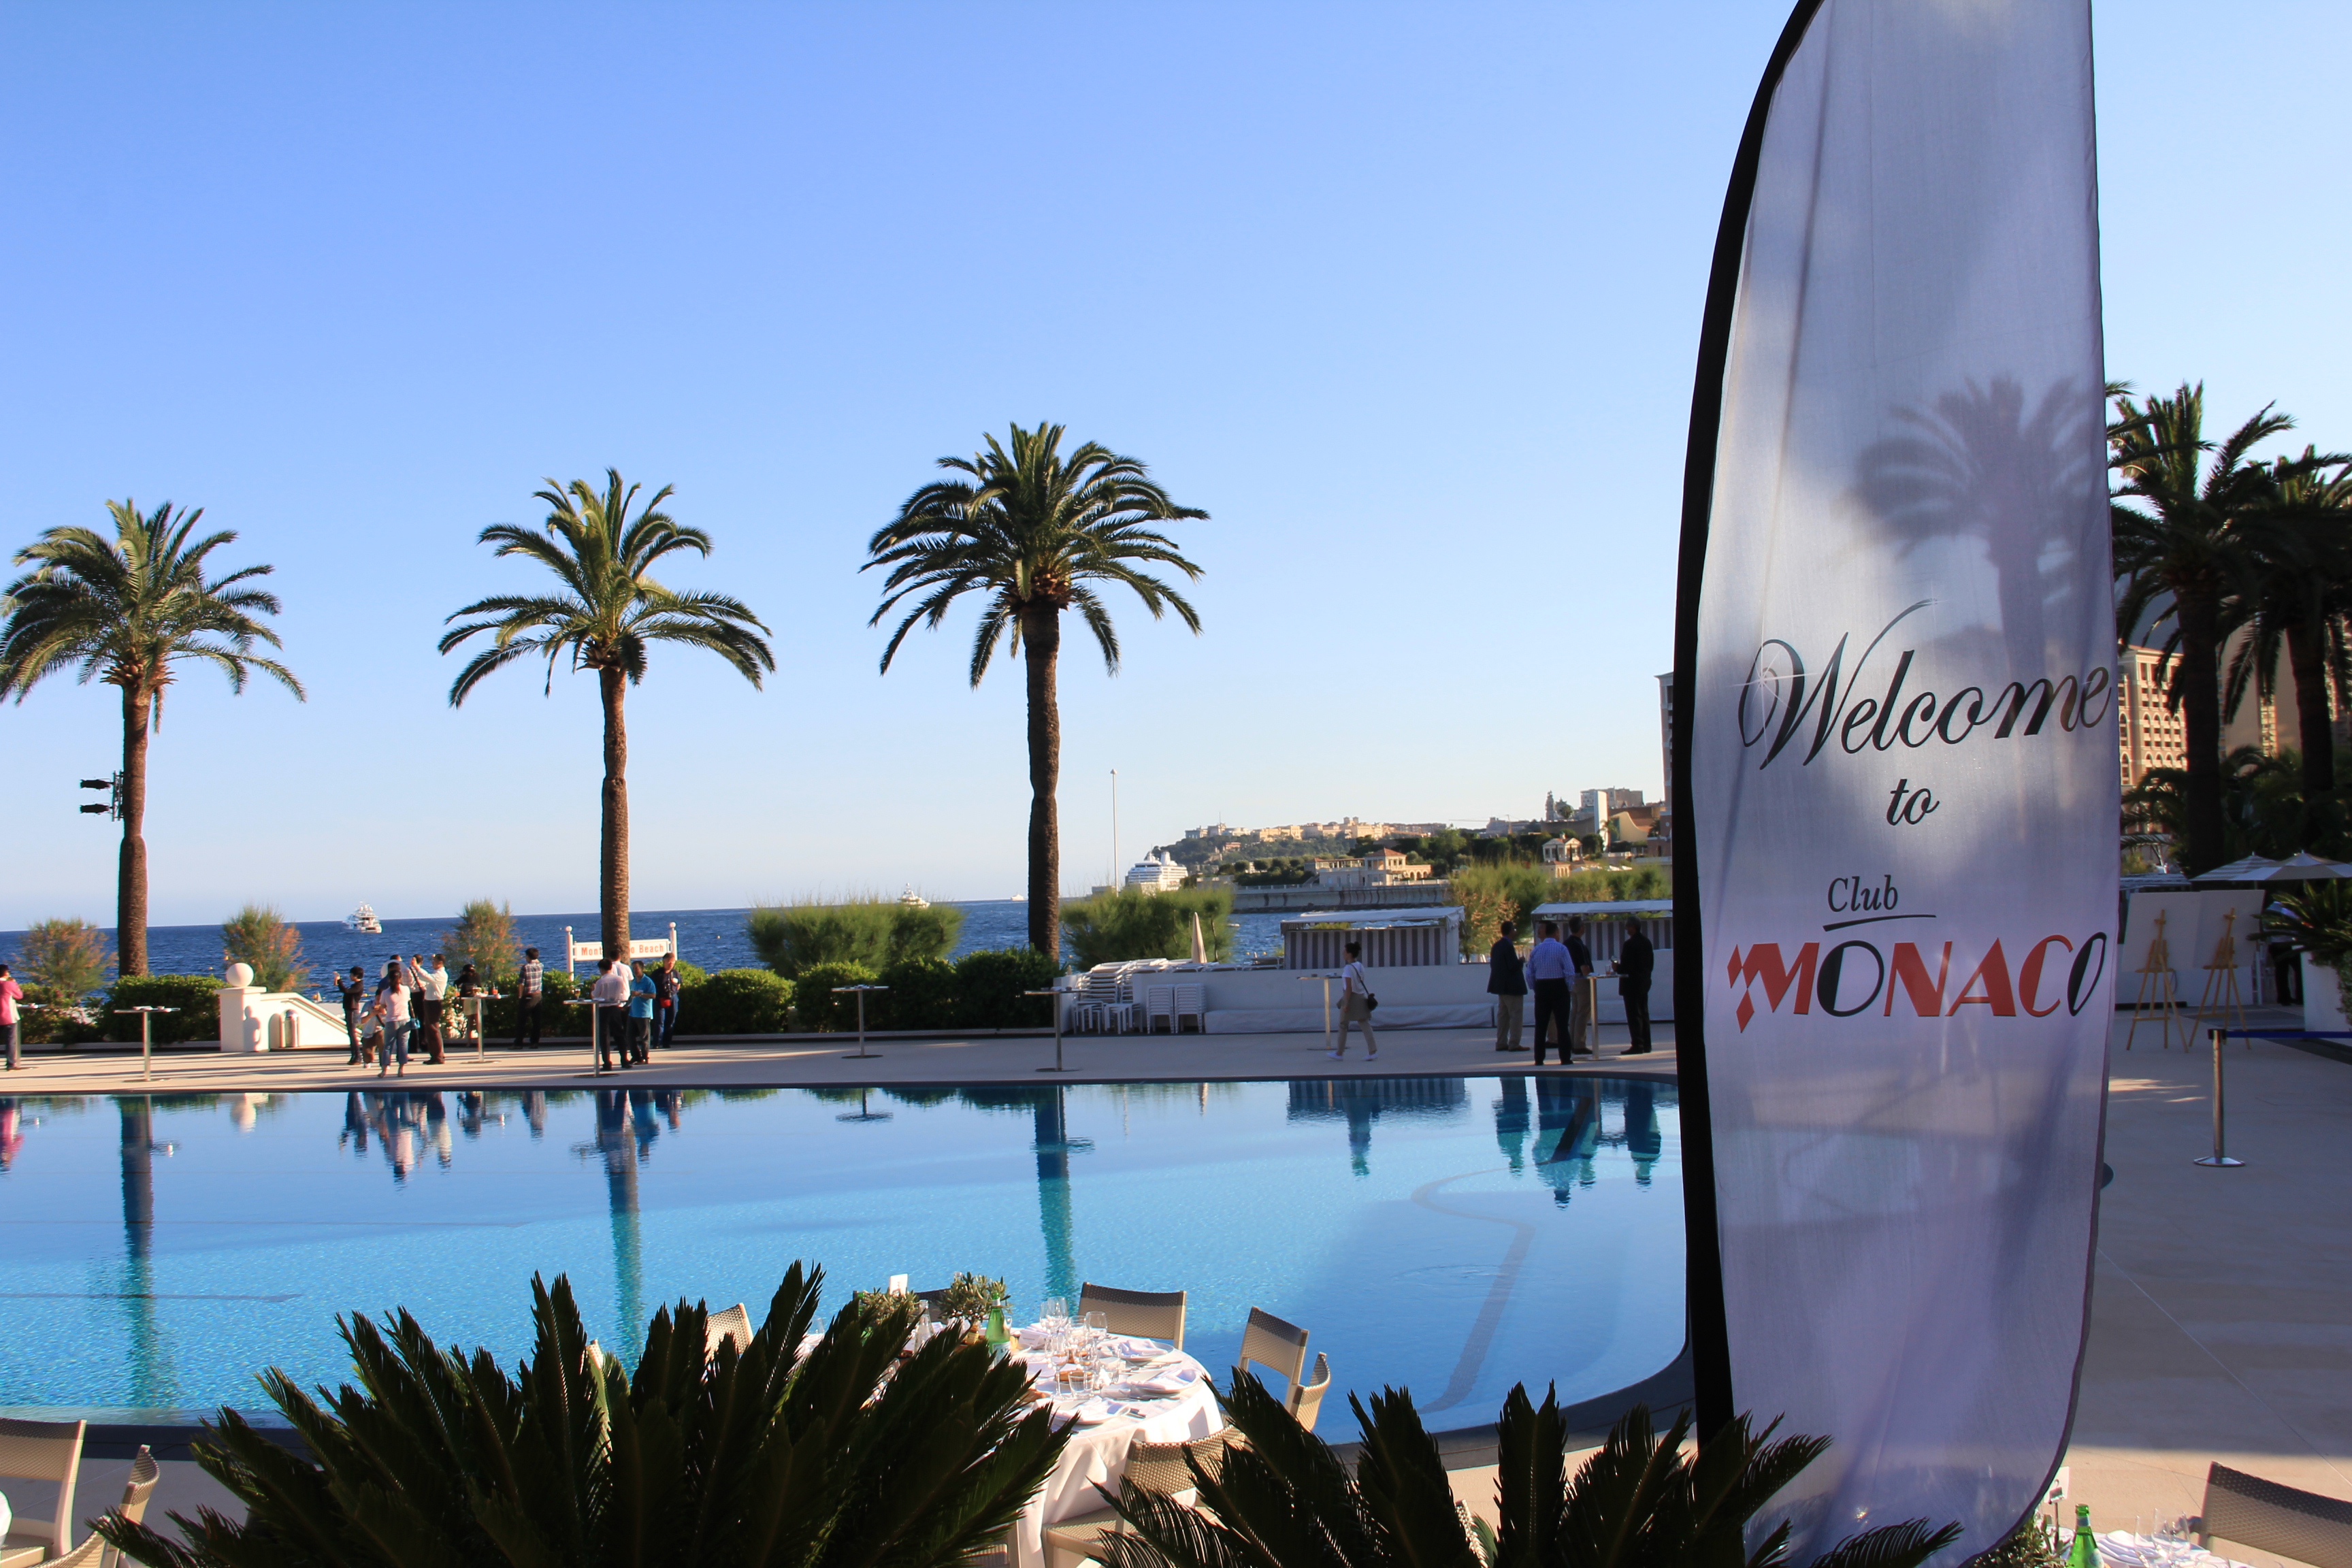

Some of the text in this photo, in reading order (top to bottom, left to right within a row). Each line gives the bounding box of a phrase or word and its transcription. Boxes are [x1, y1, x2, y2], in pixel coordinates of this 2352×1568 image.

[1738, 598, 2111, 770] Welcome
[1886, 779, 1940, 826] to
[1827, 875, 1898, 912] Club
[581, 946, 603, 956] Mont
[639, 943, 664, 953] Beach
[1727, 931, 2108, 1034] MONACO
